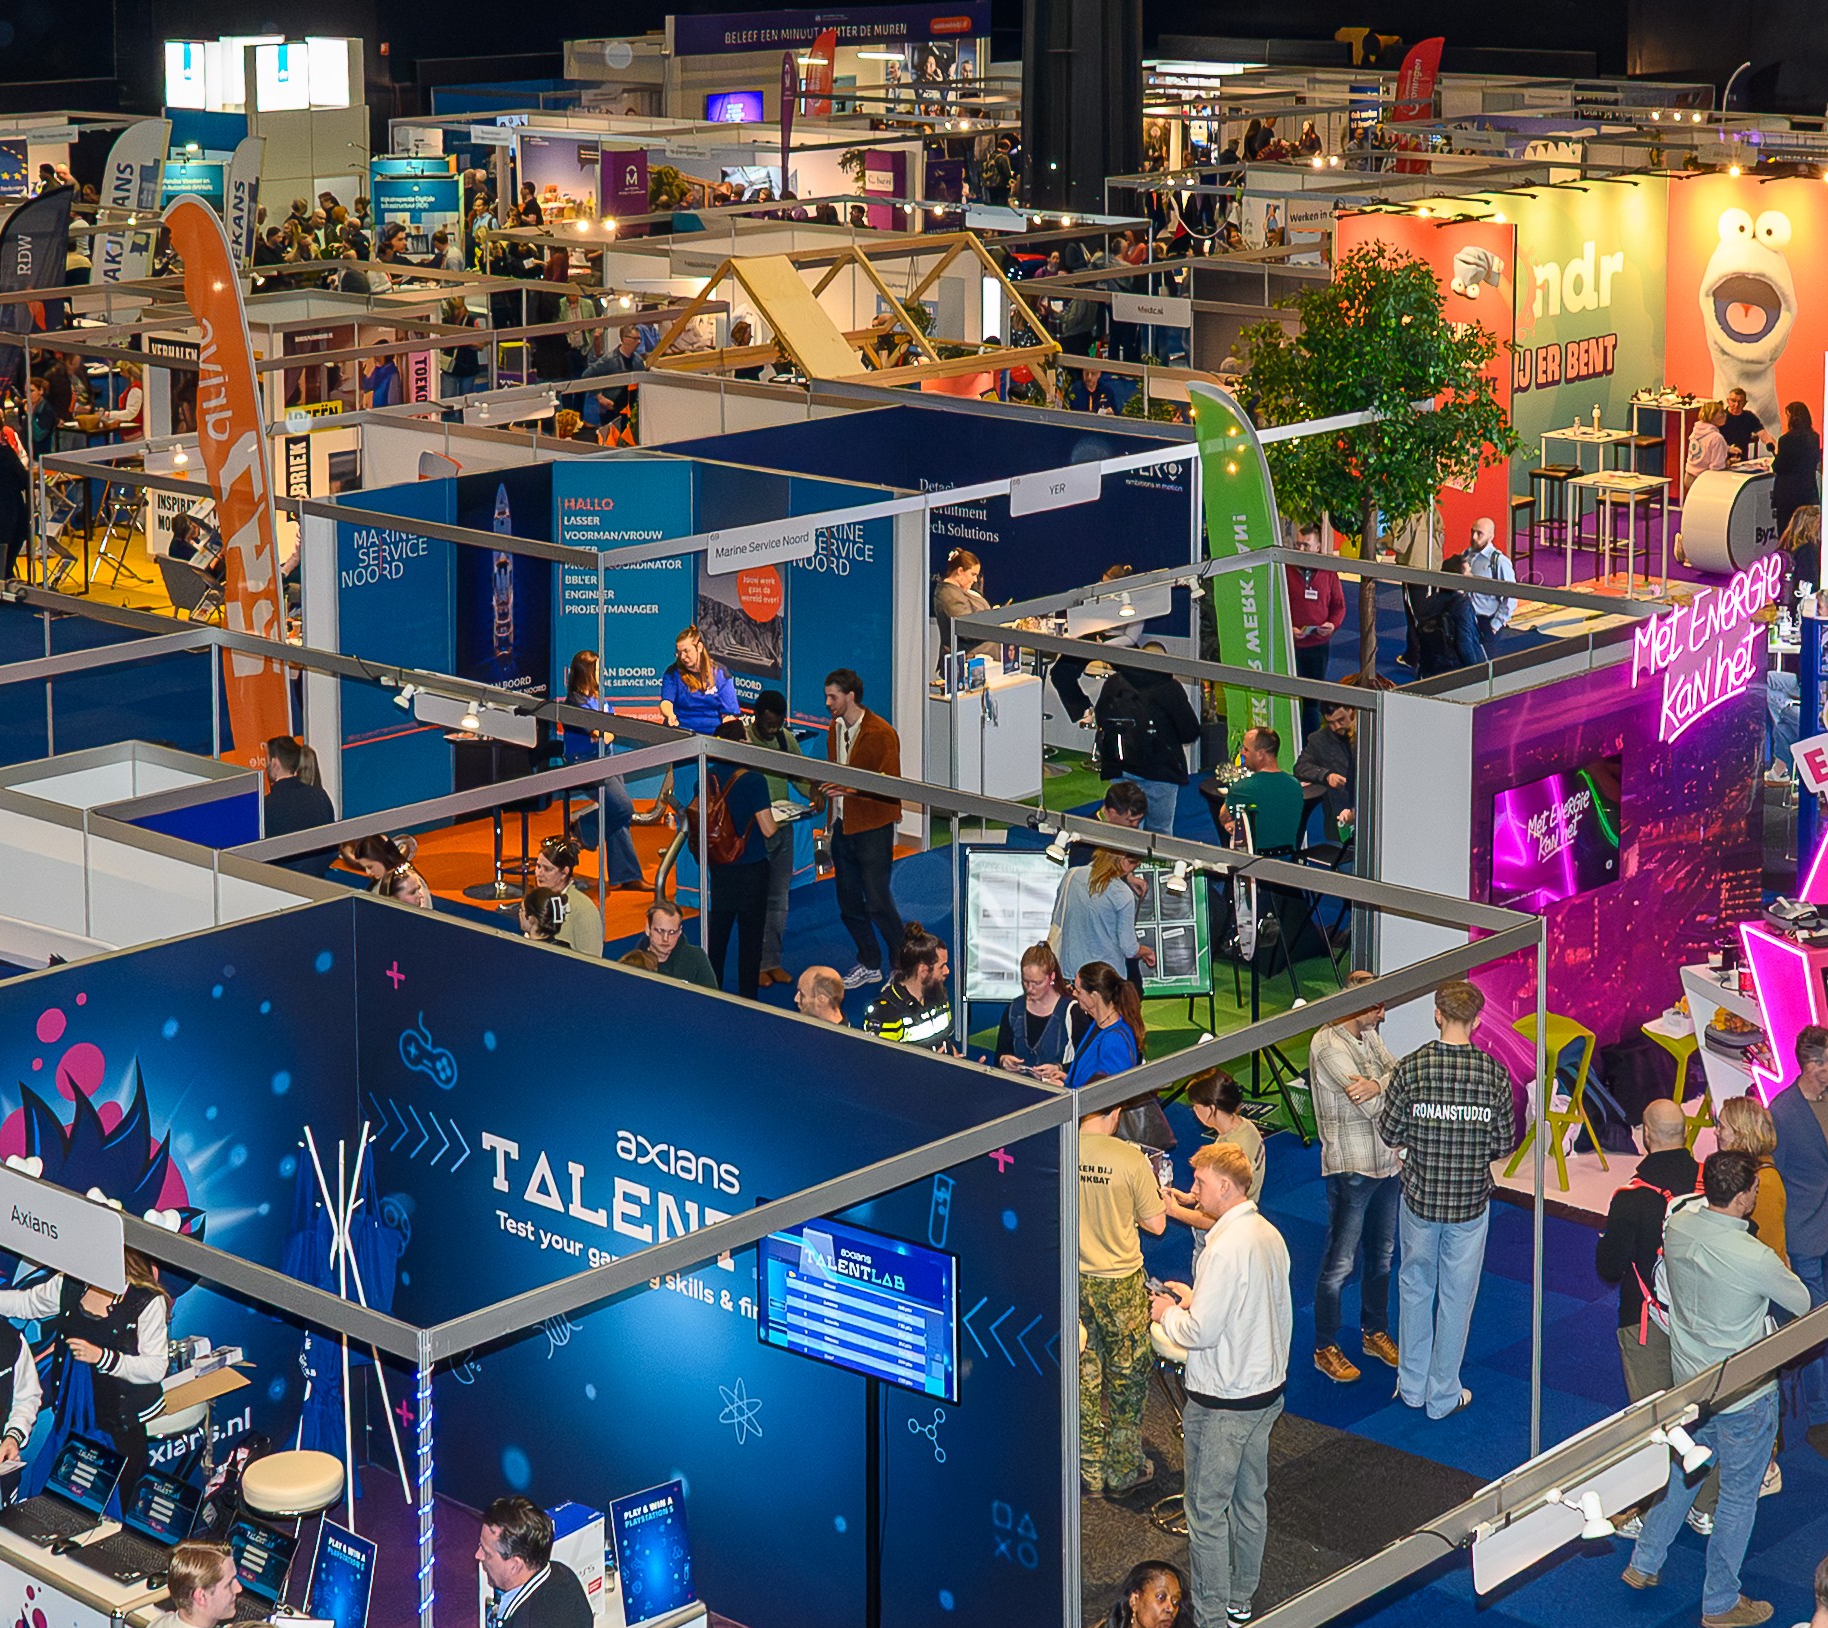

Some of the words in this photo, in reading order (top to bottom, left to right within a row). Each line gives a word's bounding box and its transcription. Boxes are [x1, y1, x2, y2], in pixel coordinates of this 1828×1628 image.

[873, 23, 907, 35] MUREN
[17, 234, 33, 276] RDW
[149, 342, 199, 361] VERHALEN
[1536, 347, 1562, 387] ER
[1565, 334, 1618, 377] BENT
[1049, 483, 1067, 496] YER
[564, 498, 614, 511] HALLO
[564, 516, 600, 527] LASSER
[564, 530, 663, 542] VOORMAN/VROUW
[947, 525, 1000, 544] Solutions
[358, 539, 428, 567] SERVICE
[714, 543, 747, 560] Marine
[748, 539, 781, 555] Service
[782, 532, 810, 551] Noord
[341, 561, 405, 589] NOORD
[792, 555, 851, 577] NOORD
[1632, 604, 1688, 688] Met
[619, 667, 656, 678] BOORD
[1712, 622, 1766, 701] het
[615, 1130, 742, 1196] axians
[10, 1203, 60, 1244] Axians
[496, 1211, 536, 1244] Test
[539, 1227, 583, 1262] your
[666, 1268, 716, 1307] skills
[719, 1288, 735, 1312] &
[840, 1248, 872, 1264] axians
[804, 1247, 907, 1291] TALENTLAB
[623, 1506, 643, 1521] PLAY
[649, 1499, 666, 1514] WIN
[624, 1509, 669, 1528] PLAYSTATION
